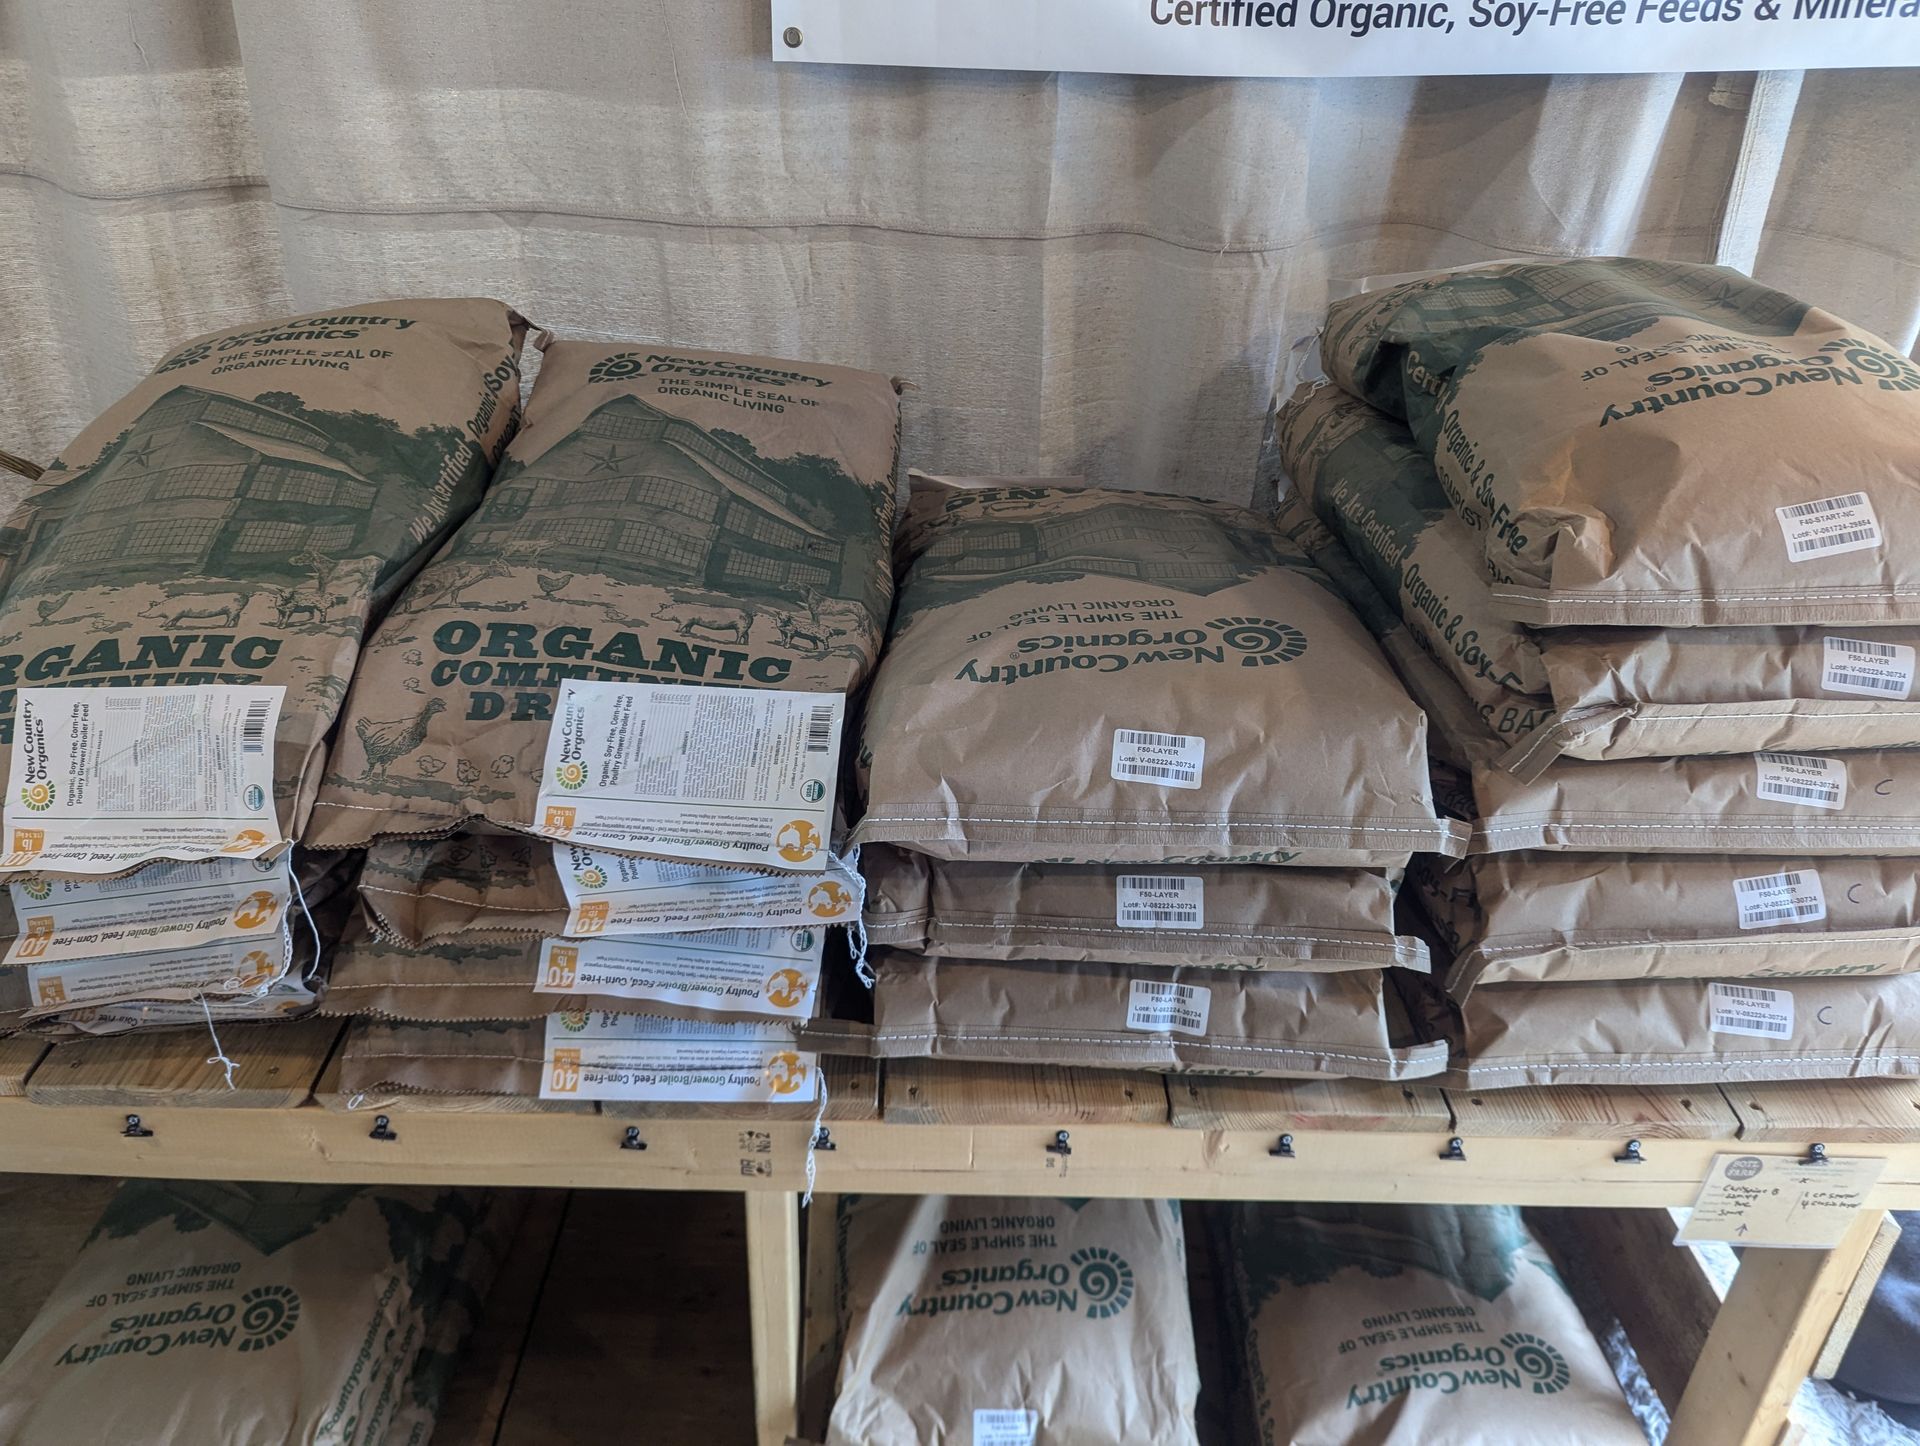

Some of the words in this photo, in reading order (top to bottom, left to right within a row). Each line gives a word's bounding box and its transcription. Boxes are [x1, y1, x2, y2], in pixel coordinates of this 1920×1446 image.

[1150, 0, 1297, 27] Certified
[1309, 0, 1456, 37] Organic,
[1468, 0, 1626, 36] Soy-Free
[1636, 0, 1742, 24] Feeds
[1753, 0, 1781, 21] &
[287, 315, 419, 329] Country
[217, 326, 361, 351] Organics
[218, 351, 248, 364] THE
[252, 348, 315, 358] SIMPLE
[369, 349, 394, 359] OF
[1610, 349, 1669, 369] SEAL
[211, 358, 287, 375] ORGANIC
[290, 358, 349, 371] LIVING
[645, 354, 713, 367] New
[712, 361, 832, 388] Country
[650, 363, 787, 387] Organics
[1581, 367, 1609, 382] OF
[1647, 353, 1834, 387] Organics
[1776, 366, 1863, 386] New
[659, 377, 692, 387] THE
[694, 380, 753, 398] SIMPLE
[756, 390, 796, 404] SEAL
[657, 386, 731, 402] ORGANIC
[732, 397, 785, 414] LIVING
[1599, 377, 1774, 428] Country
[1443, 409, 1479, 474] Organic
[1470, 459, 1486, 488] &
[1476, 473, 1528, 557] SoyFree
[1799, 510, 1856, 526] F40-START-NC
[409, 517, 438, 545] We
[1341, 493, 1366, 524] Are
[1361, 508, 1407, 570] Certified
[1791, 529, 1812, 540] Lot#:
[1009, 601, 1077, 620] LIVING
[1082, 599, 1175, 610] ORGANIC
[1004, 613, 1054, 632] SEAL
[1057, 610, 1138, 624] SIMPLE
[1141, 610, 1183, 621] THE
[1403, 563, 1450, 631] Organic
[1444, 614, 1464, 643] &
[1455, 630, 1524, 687] Soy-F
[965, 630, 998, 644] OF
[1016, 628, 1207, 655] Organics
[432, 620, 792, 684] ORGANIC
[1129, 645, 1225, 664] New
[1848, 654, 1890, 665] F50-LAYER
[954, 652, 1130, 685] Country
[1830, 663, 1849, 671] Lot#:
[81, 703, 89, 722] Feed
[610, 694, 625, 727] Corn-free,
[626, 696, 634, 712] Feed
[23, 699, 34, 754] Country
[71, 701, 81, 739] Corn-free,
[571, 706, 586, 761] Organics
[604, 726, 617, 758] Soy-Free,
[614, 711, 630, 760] Grower/Broiler
[34, 718, 48, 780] Organics
[69, 739, 79, 775] Soy-Free,
[78, 722, 89, 776] Grower/Broiler
[560, 737, 571, 764] New
[1137, 746, 1179, 756] F50-LAYER
[24, 755, 36, 784] New
[1139, 757, 1196, 769] V-082224-30734
[1780, 765, 1823, 777] F50-LAYER
[599, 758, 610, 787] Organic,
[609, 760, 621, 786] Poultry
[1764, 773, 1783, 782] Lot#:
[67, 777, 76, 807] Organic,
[76, 778, 86, 805] Poultry
[553, 816, 564, 826] lb
[22, 839, 33, 849] lb
[576, 830, 626, 841] Corn-Free
[629, 833, 656, 843] Feed,
[657, 835, 731, 849] Grower/Broiler
[732, 842, 769, 851] Poultry
[40, 852, 87, 861] Corn-Free
[89, 852, 115, 862] Feed,
[1139, 891, 1180, 899] F50-LAYER
[1758, 887, 1797, 899] F50-LAYER
[766, 907, 802, 917] Poultry
[1142, 902, 1197, 910] V-082224-30734
[1744, 903, 1762, 911] Lot#:
[196, 916, 228, 930] Poultry
[610, 915, 660, 925] Corn-Free
[663, 914, 690, 923] Feed,
[691, 909, 764, 921] Grower/Broiler
[126, 923, 194, 938] Grower/Broiler
[576, 918, 605, 933] 40
[53, 934, 99, 946] Corn-Free
[100, 930, 125, 943] Feed,
[19, 938, 49, 956] 40
[557, 955, 568, 965] lb
[549, 966, 576, 987] 40
[656, 979, 724, 996] Grower/Broiler
[725, 985, 760, 999] Poultry
[1150, 996, 1187, 1005] F50-LAYER
[1732, 999, 1771, 1009] F50-LAYER
[1716, 1007, 1734, 1015] Lot#:
[552, 1071, 579, 1091] 40
[583, 1072, 629, 1085] Corn-Free
[633, 1073, 657, 1086] Feed,
[657, 1073, 726, 1087] Grower/Broiler
[728, 1076, 761, 1087] Poultry
[940, 1218, 988, 1234] LIVING
[992, 1215, 1056, 1230] ORGANIC
[931, 1237, 967, 1254] SEAL
[971, 1234, 1025, 1250] SIMPLE
[1029, 1234, 1058, 1248] THE
[126, 1268, 175, 1286] LIVING
[176, 1261, 242, 1278] ORGANIC
[941, 1258, 1070, 1290] Organics
[150, 1282, 204, 1298] SIMPLE
[206, 1278, 235, 1291] THE
[85, 1294, 107, 1308] OF
[111, 1289, 147, 1304] SEAL
[896, 1290, 1014, 1317] Country
[1016, 1288, 1078, 1312] New
[109, 1301, 237, 1335] Organics
[1361, 1312, 1410, 1330] LIVING
[1414, 1305, 1476, 1321] ORGANIC
[1399, 1321, 1454, 1340] SIMPLE
[1456, 1320, 1486, 1334] THE
[167, 1325, 238, 1348] New
[1358, 1329, 1397, 1348] SEAL
[54, 1331, 170, 1367] Country
[1337, 1340, 1357, 1355] OF
[1378, 1342, 1506, 1372] Organics
[1461, 1367, 1522, 1390] New
[1345, 1369, 1460, 1410] Country
